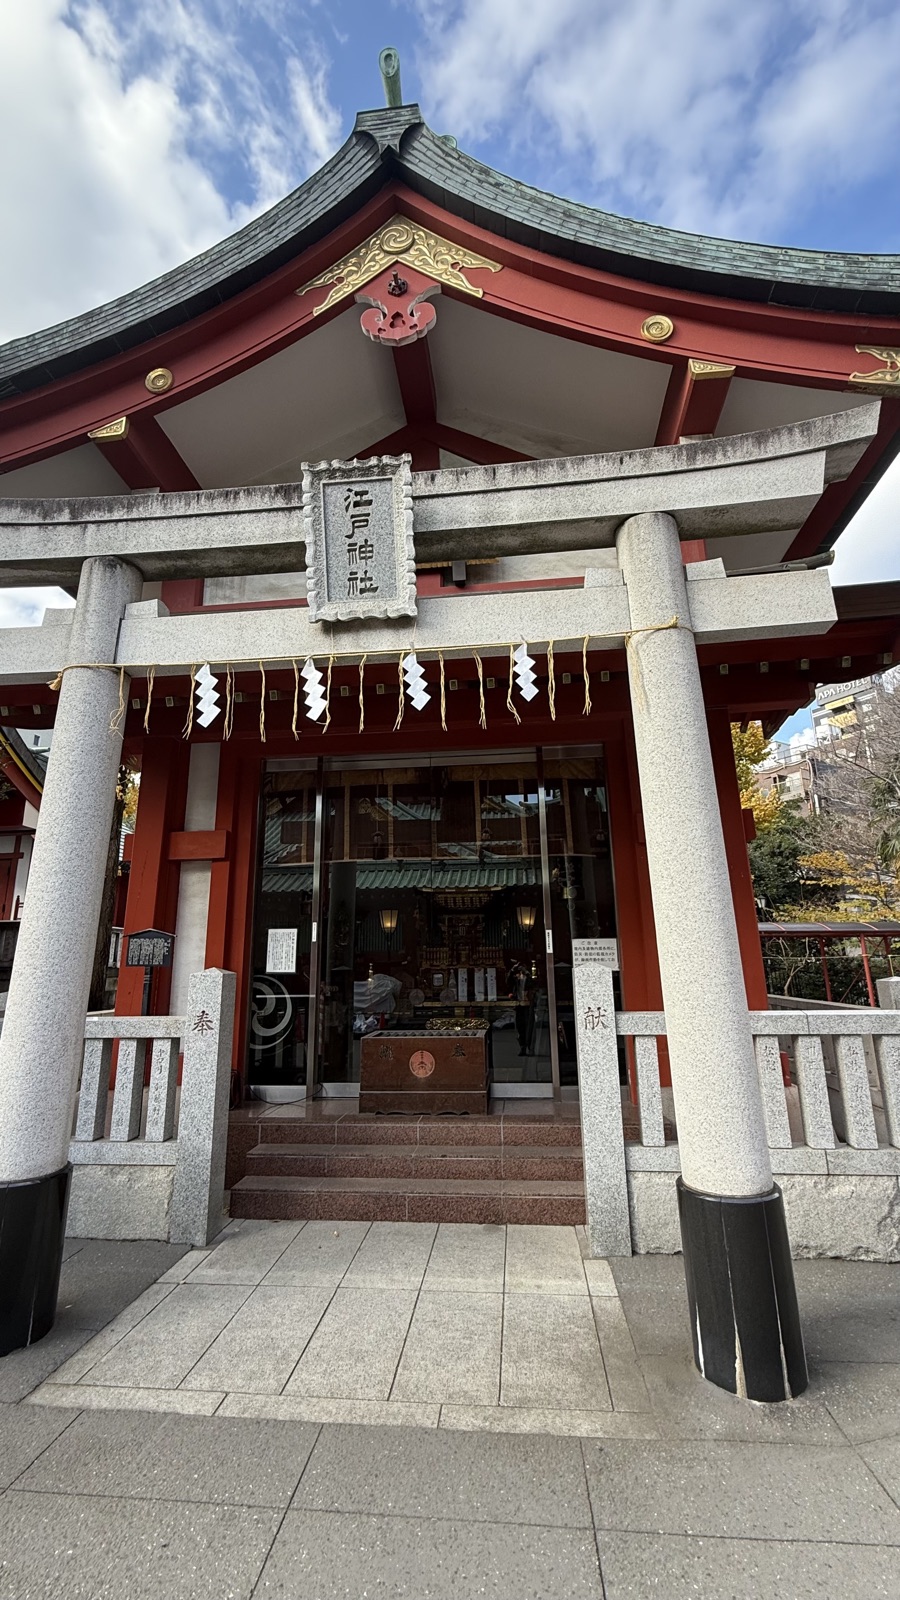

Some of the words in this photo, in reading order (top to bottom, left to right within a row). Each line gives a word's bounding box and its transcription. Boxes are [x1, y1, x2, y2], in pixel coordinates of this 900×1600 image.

[343, 487, 379, 597] 江戸神社
[818, 689, 836, 699] APA
[837, 678, 868, 693] HOTEL
[192, 1010, 214, 1035] 奉
[583, 1006, 608, 1031] 献
